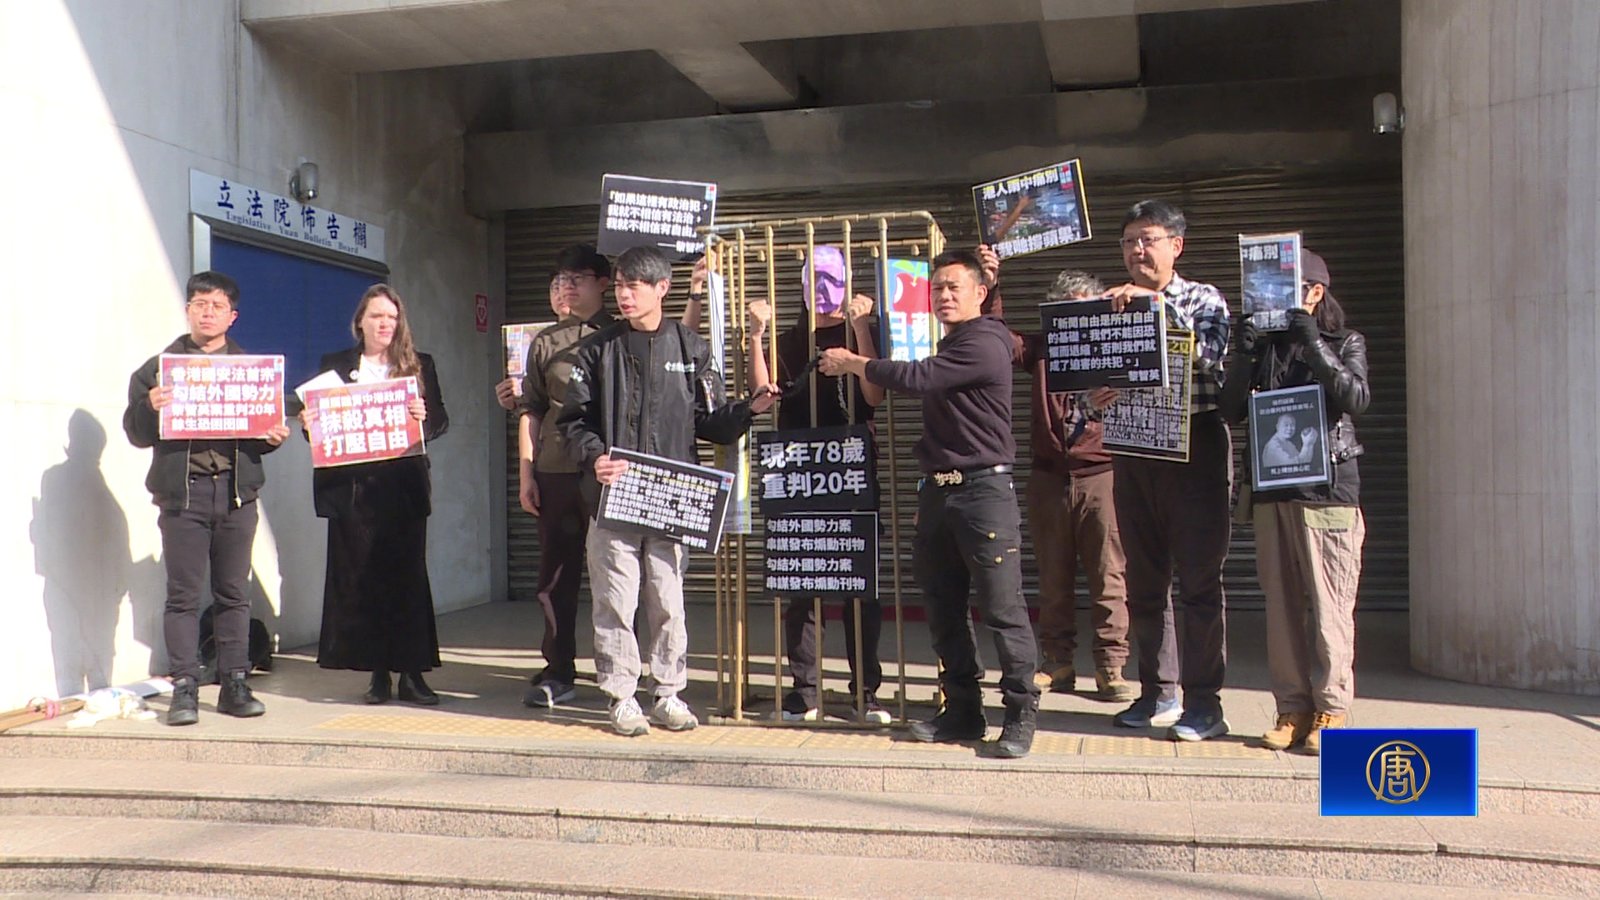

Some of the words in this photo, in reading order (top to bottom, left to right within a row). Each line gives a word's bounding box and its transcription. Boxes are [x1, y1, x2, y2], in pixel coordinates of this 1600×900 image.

[172, 383, 275, 402] 勾結外國勢力
[320, 405, 407, 434] 抹殺真相
[322, 428, 409, 458] 打壓自由
[760, 436, 866, 469] 現年78歲
[761, 468, 867, 499] 重判20年
[767, 518, 852, 534] 勾結外國勢力案
[766, 537, 865, 552] 串謀發布煽動刊物
[766, 557, 852, 573] 勾結外國勢力案
[766, 576, 866, 591] 串謀發布煽動刊物
